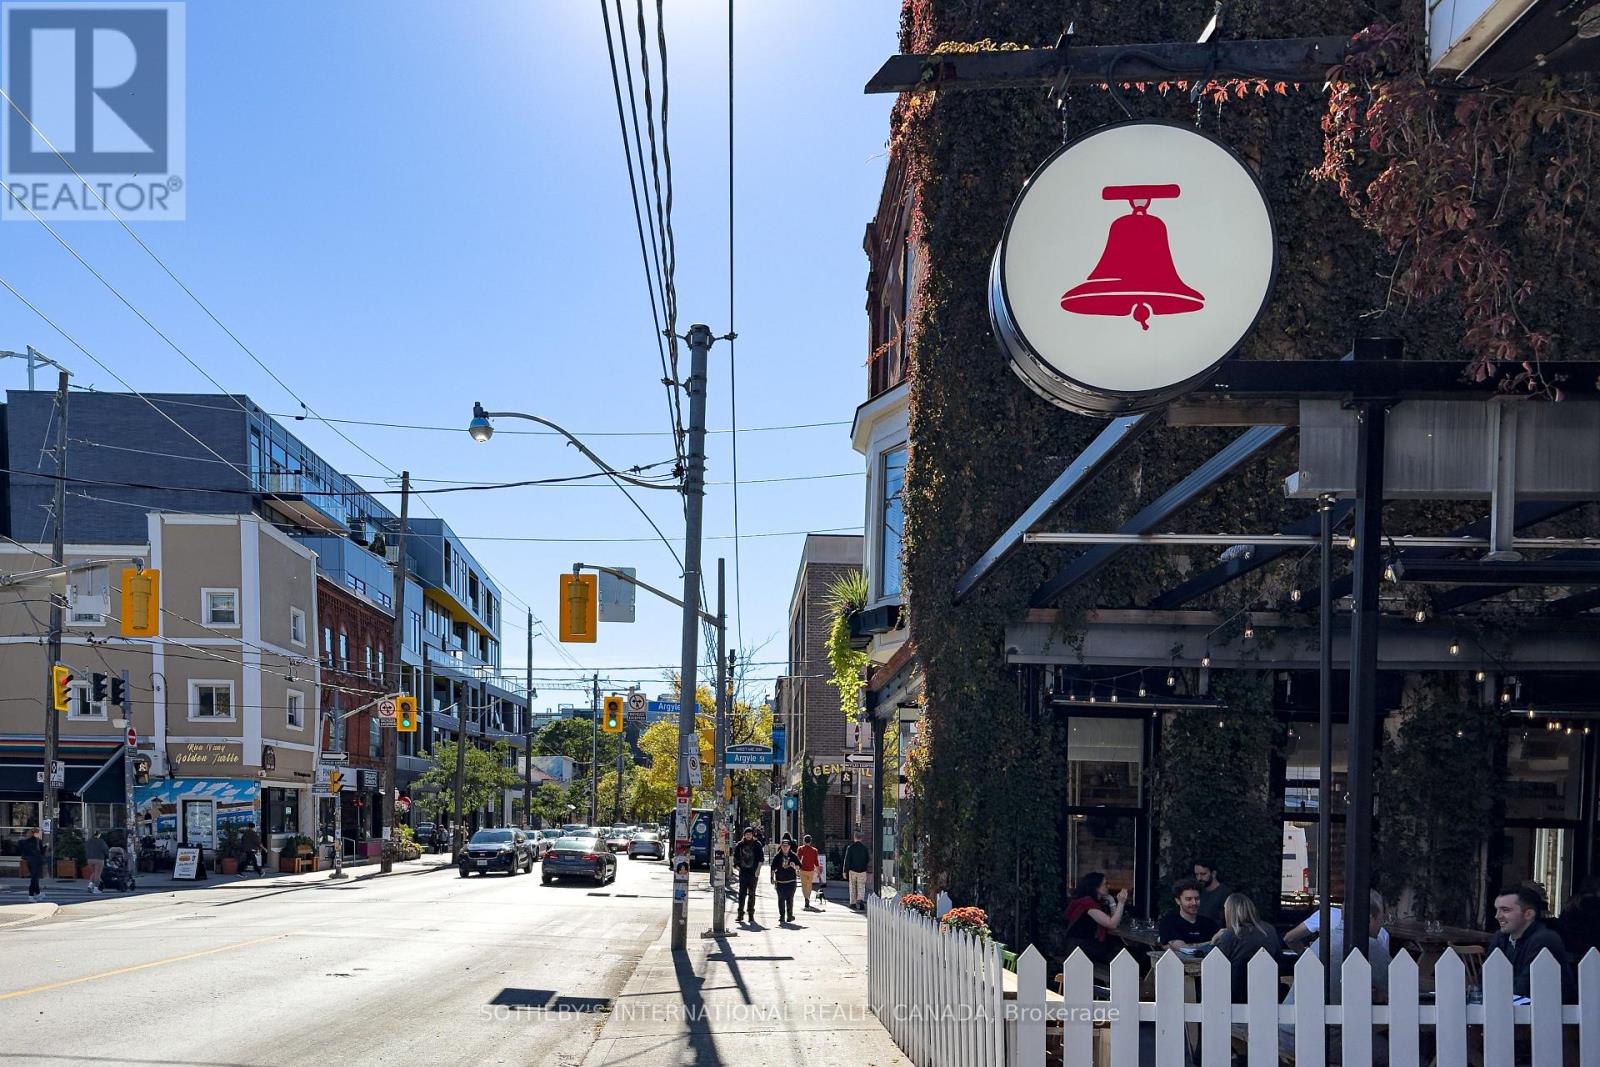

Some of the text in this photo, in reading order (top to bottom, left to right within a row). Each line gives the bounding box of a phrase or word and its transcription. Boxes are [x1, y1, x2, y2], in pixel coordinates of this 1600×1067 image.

[175, 753, 239, 765] Golden Turtle
[734, 754, 757, 764] Argyle
